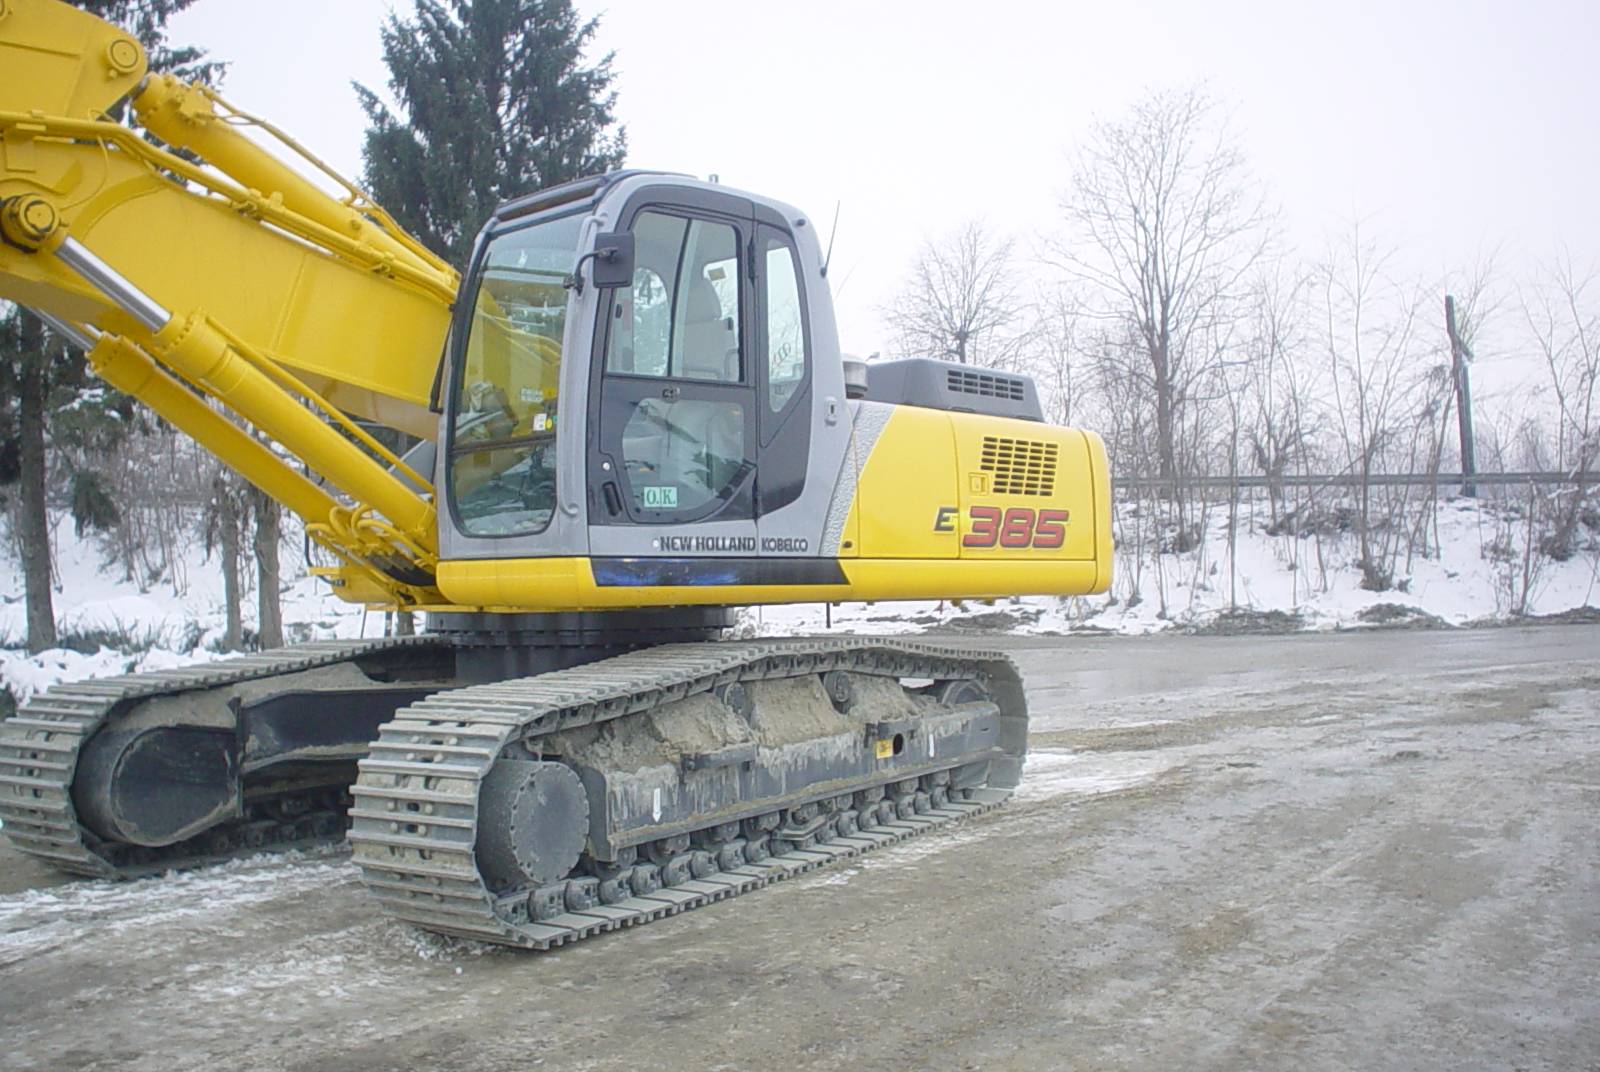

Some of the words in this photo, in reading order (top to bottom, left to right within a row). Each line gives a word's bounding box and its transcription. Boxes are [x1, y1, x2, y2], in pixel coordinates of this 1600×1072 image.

[934, 507, 959, 531] E
[962, 506, 1069, 548] 385
[660, 536, 691, 551] NEW
[696, 536, 756, 551] HOLLAND
[761, 538, 808, 552] KOBELCO
